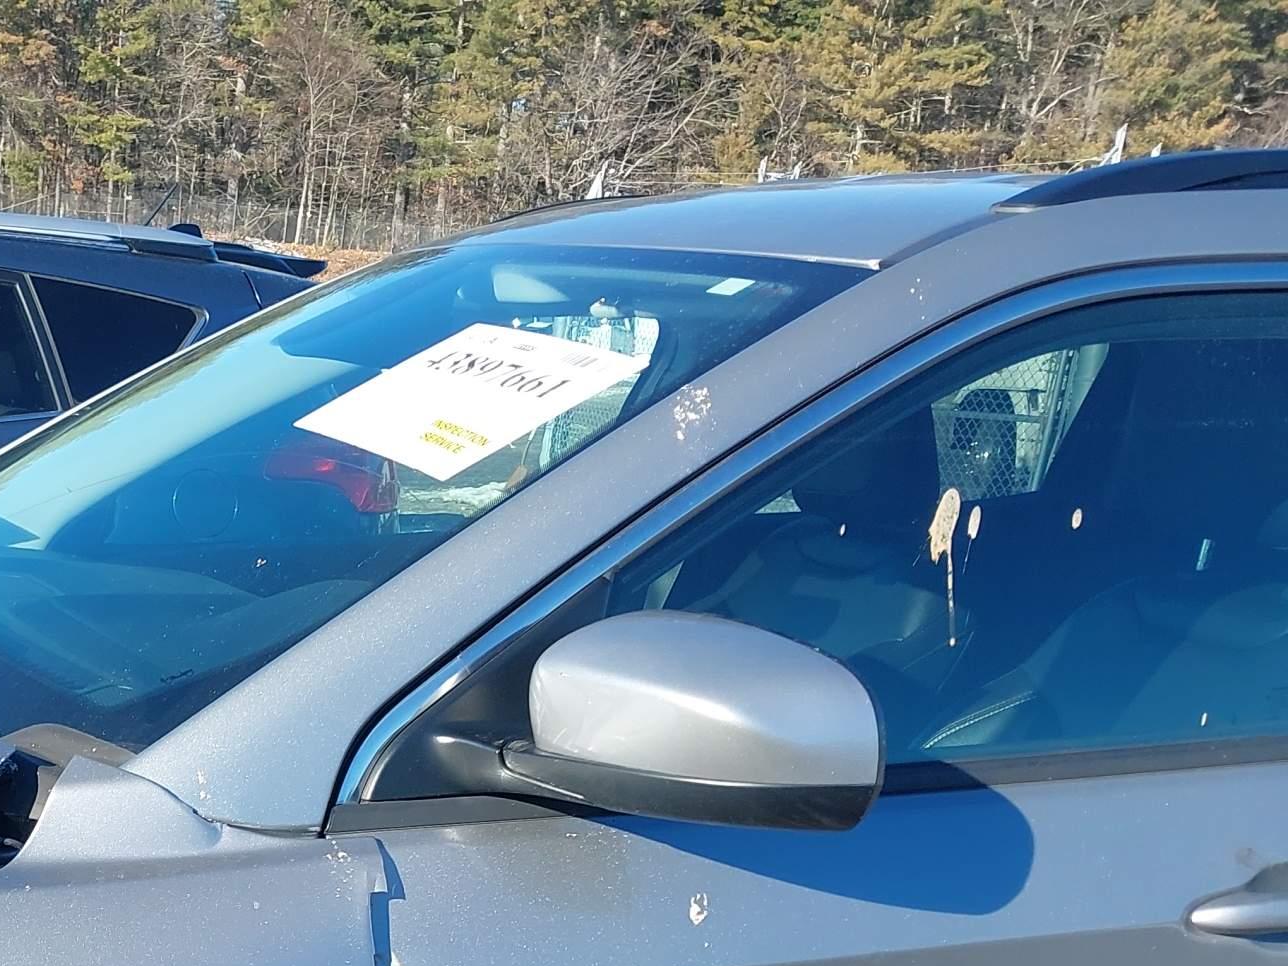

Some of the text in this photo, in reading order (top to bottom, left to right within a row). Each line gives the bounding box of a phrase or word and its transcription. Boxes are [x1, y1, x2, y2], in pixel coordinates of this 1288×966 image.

[426, 350, 571, 398] 43897661
[422, 431, 464, 453] SERVICE
[434, 419, 488, 446] INSPECTION
